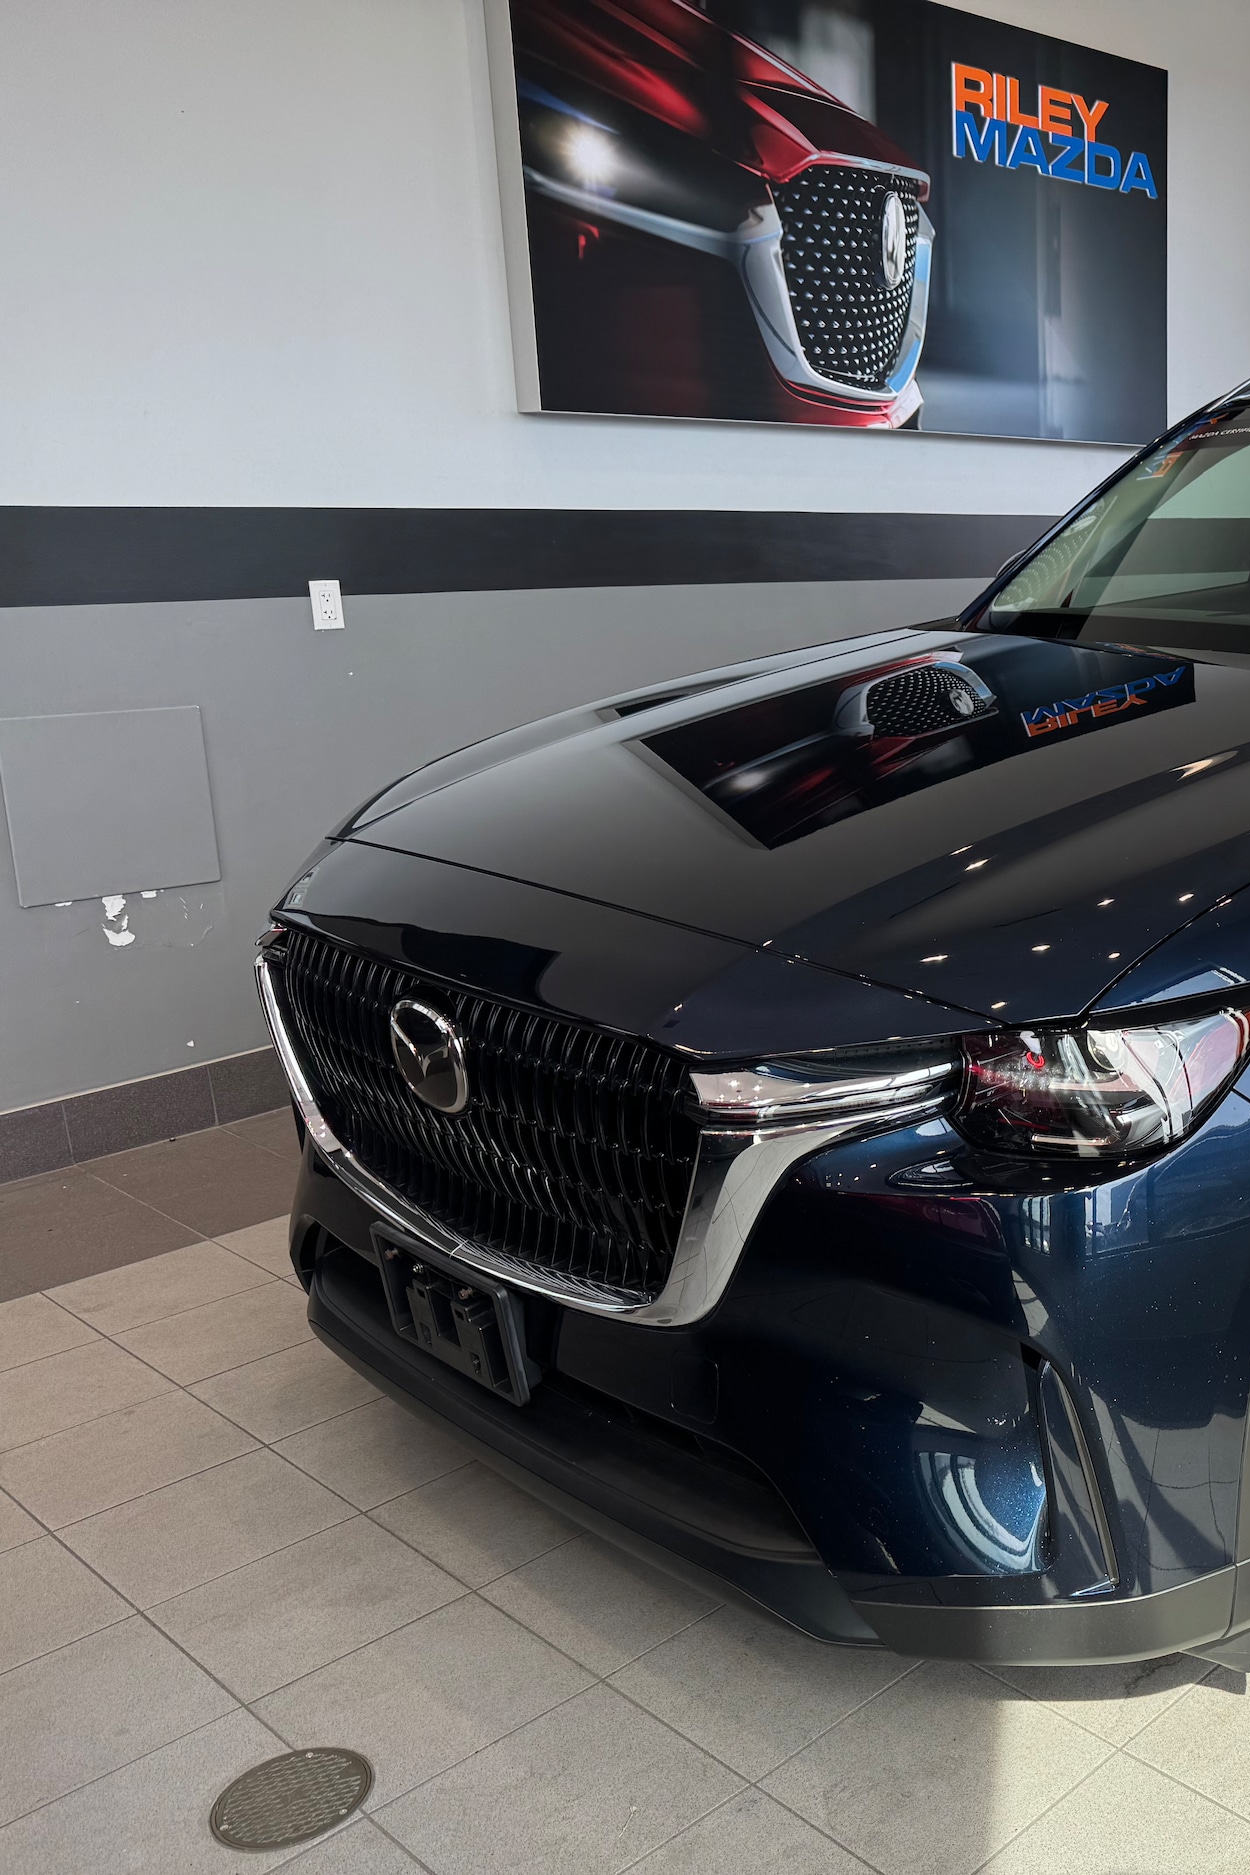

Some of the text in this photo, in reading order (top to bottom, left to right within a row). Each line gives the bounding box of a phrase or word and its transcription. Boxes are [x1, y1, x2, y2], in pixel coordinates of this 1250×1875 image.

[952, 61, 1109, 142] RILEY
[952, 109, 1158, 199] MAZDA
[1189, 431, 1219, 440] MAZDA
